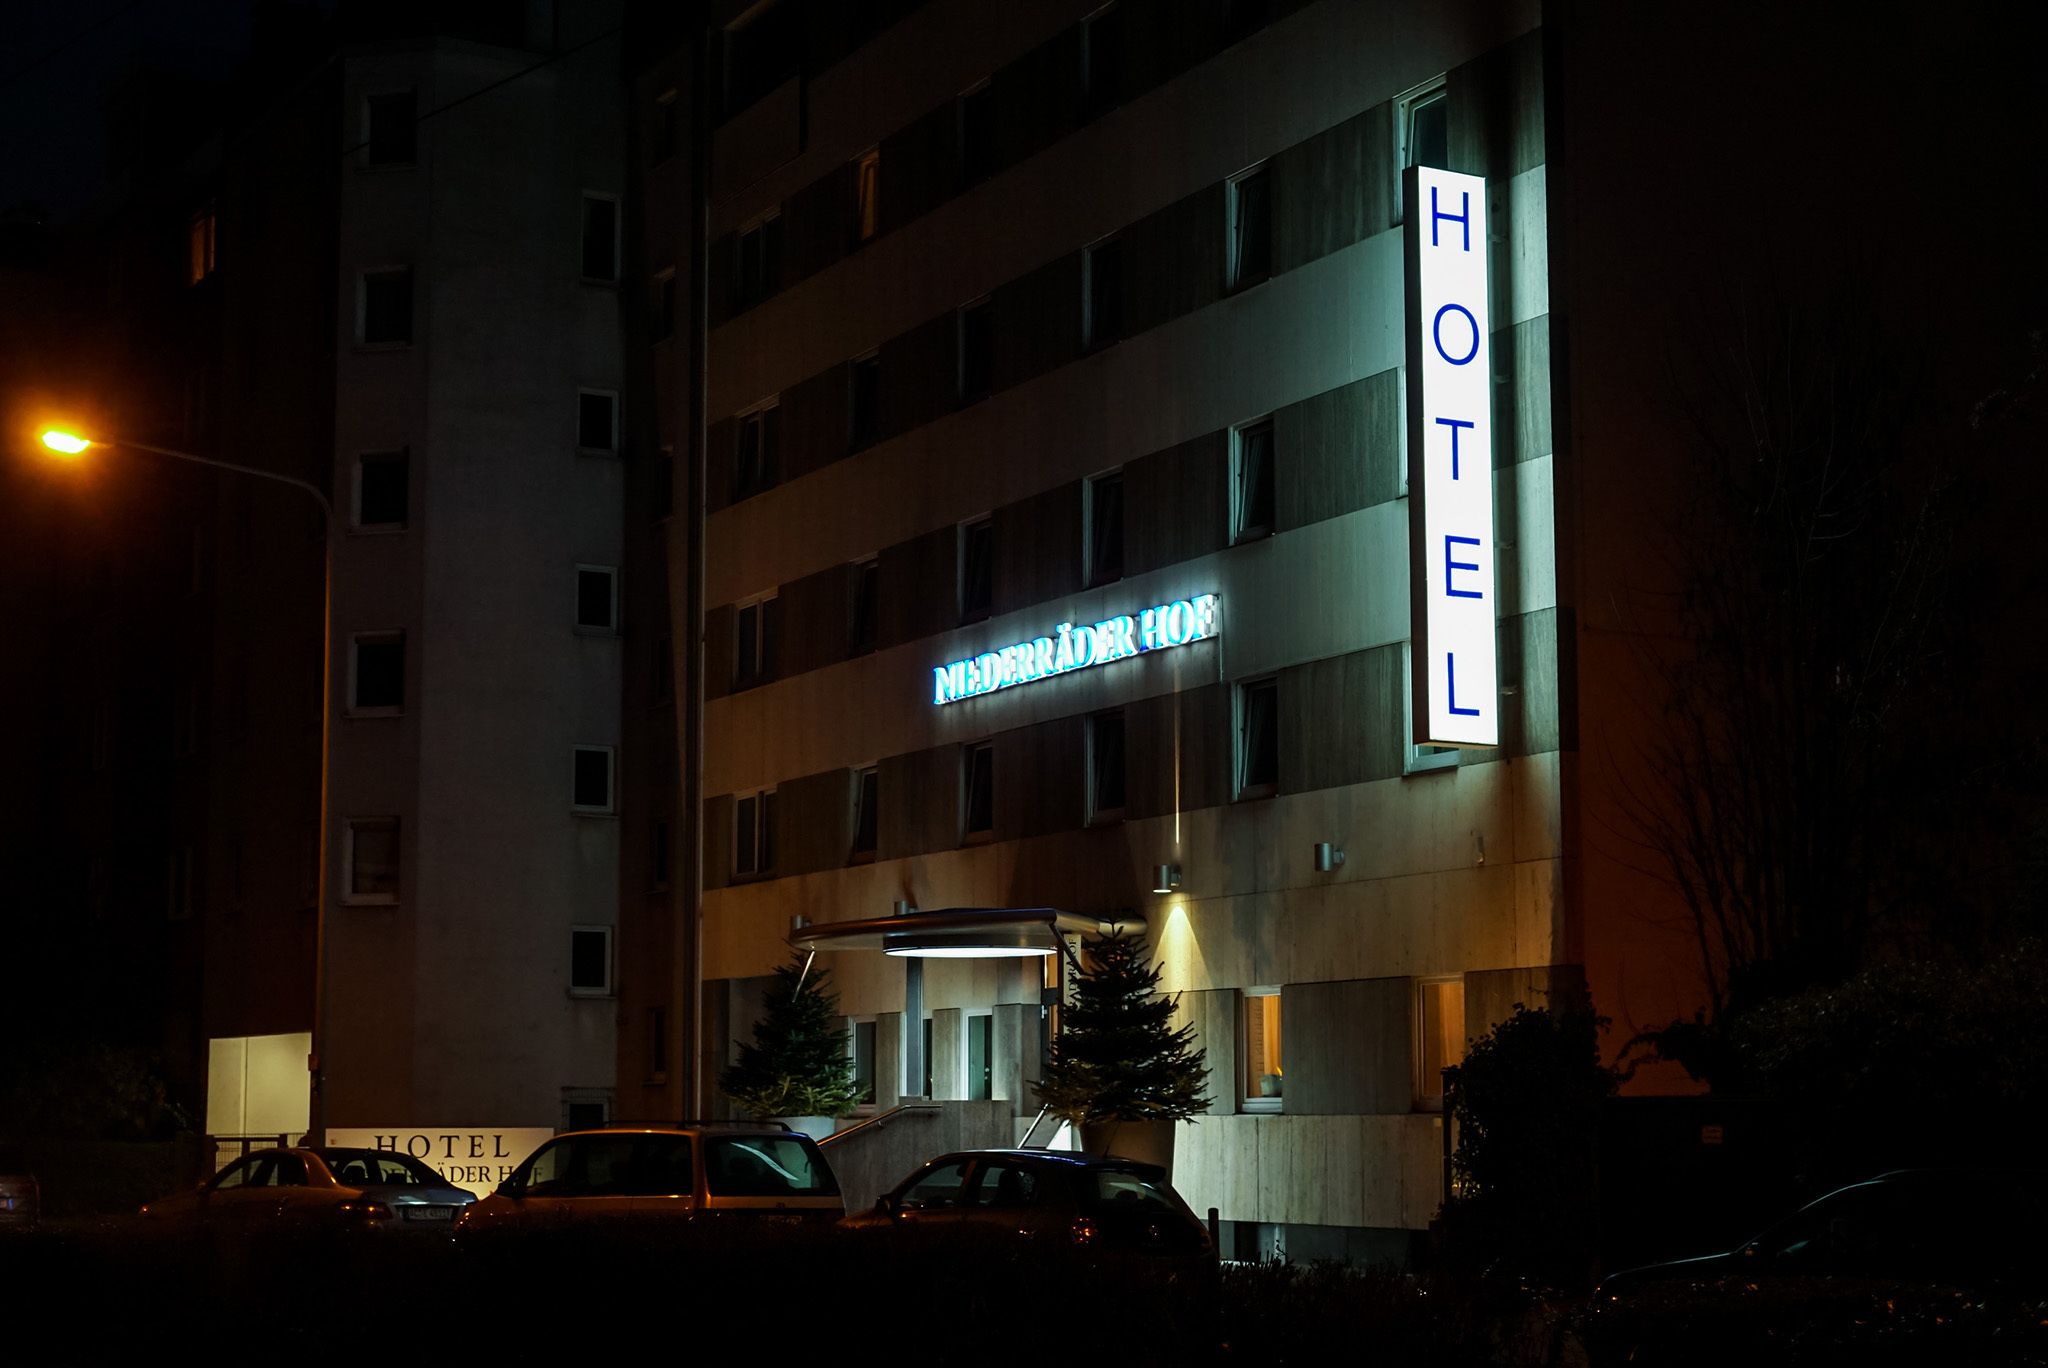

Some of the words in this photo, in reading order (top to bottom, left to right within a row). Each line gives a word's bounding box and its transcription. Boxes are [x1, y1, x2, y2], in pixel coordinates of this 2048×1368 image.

[1431, 186, 1483, 717] HOTEL
[933, 614, 1139, 705] NIEDERRÄDER
[1139, 594, 1214, 652] HOF
[374, 1134, 510, 1159] HOTEL
